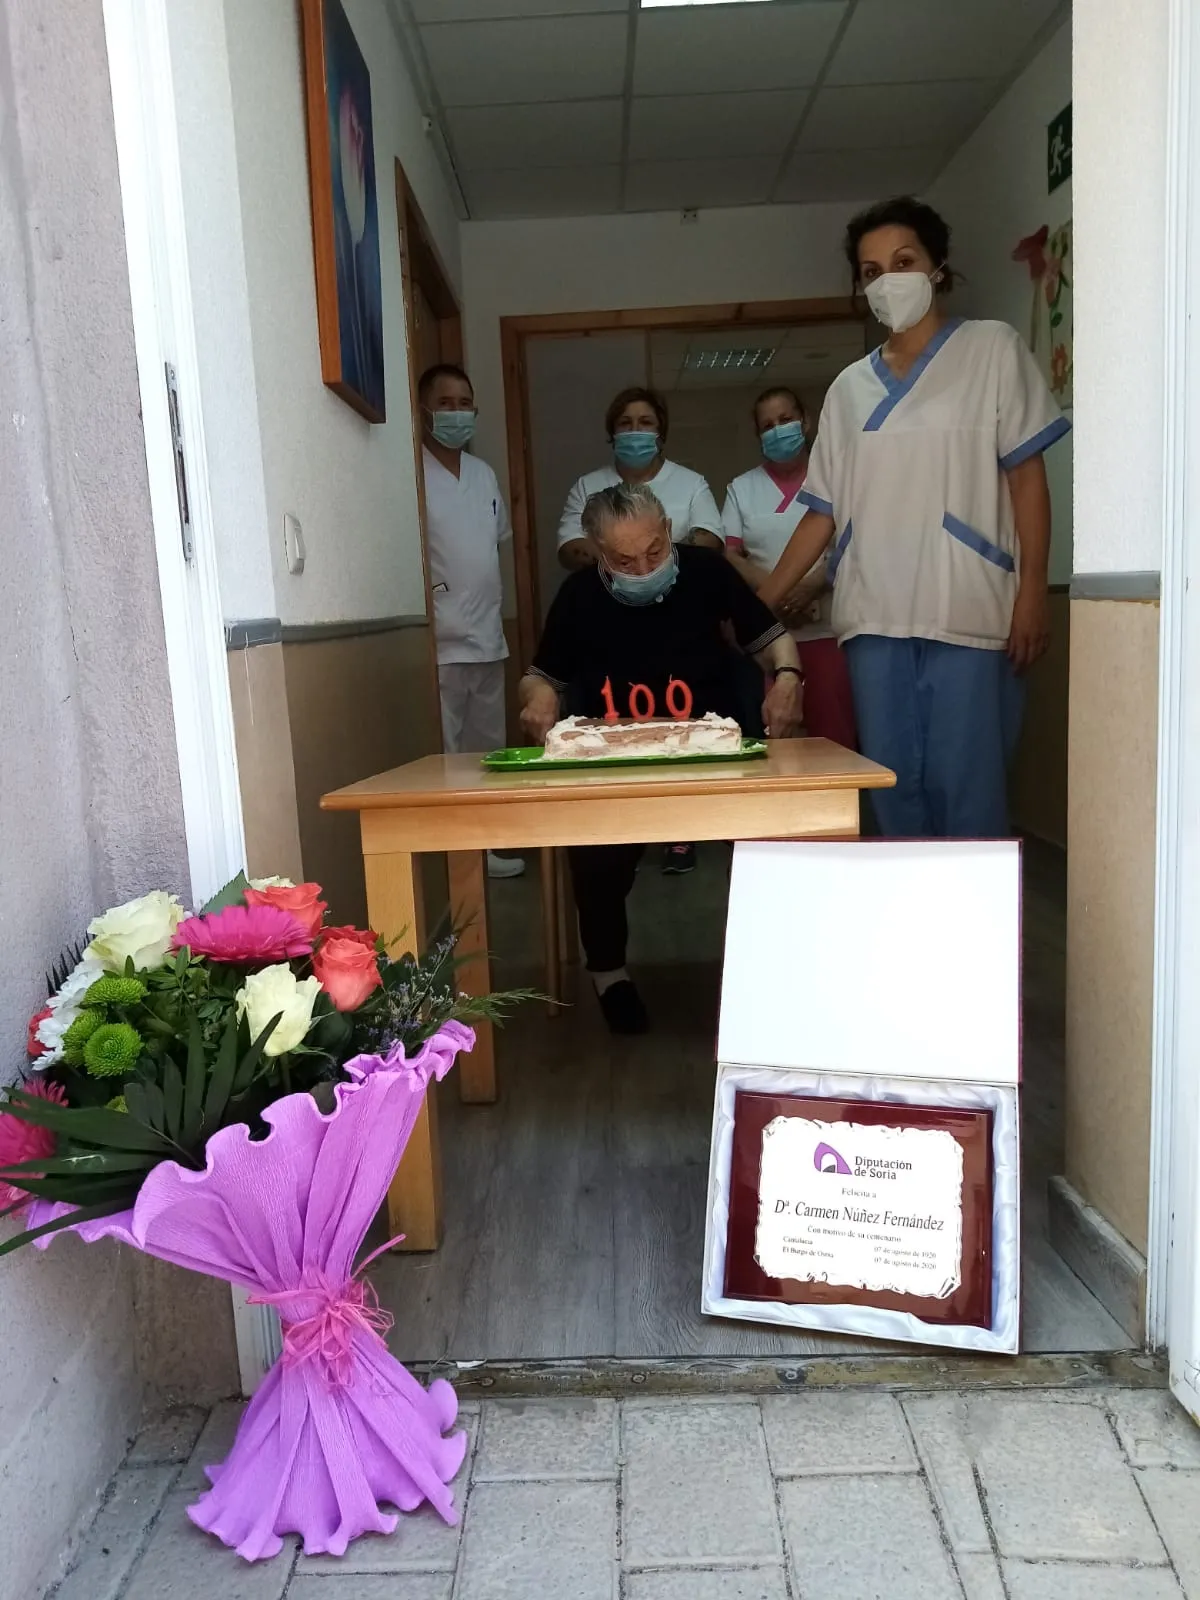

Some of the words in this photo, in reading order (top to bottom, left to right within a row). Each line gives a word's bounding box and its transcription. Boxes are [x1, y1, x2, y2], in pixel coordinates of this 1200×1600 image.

[601, 677, 693, 725] 100
[855, 1155, 912, 1170] Diputación
[854, 1166, 867, 1177] de
[869, 1168, 897, 1180] Soria
[795, 1201, 839, 1220] Carmen
[842, 1206, 880, 1224] Núñez
[883, 1210, 944, 1231] Fernández
[807, 1224, 821, 1234] Con
[822, 1227, 846, 1237] motivo
[847, 1229, 856, 1238] de
[866, 1233, 902, 1243] centenario
